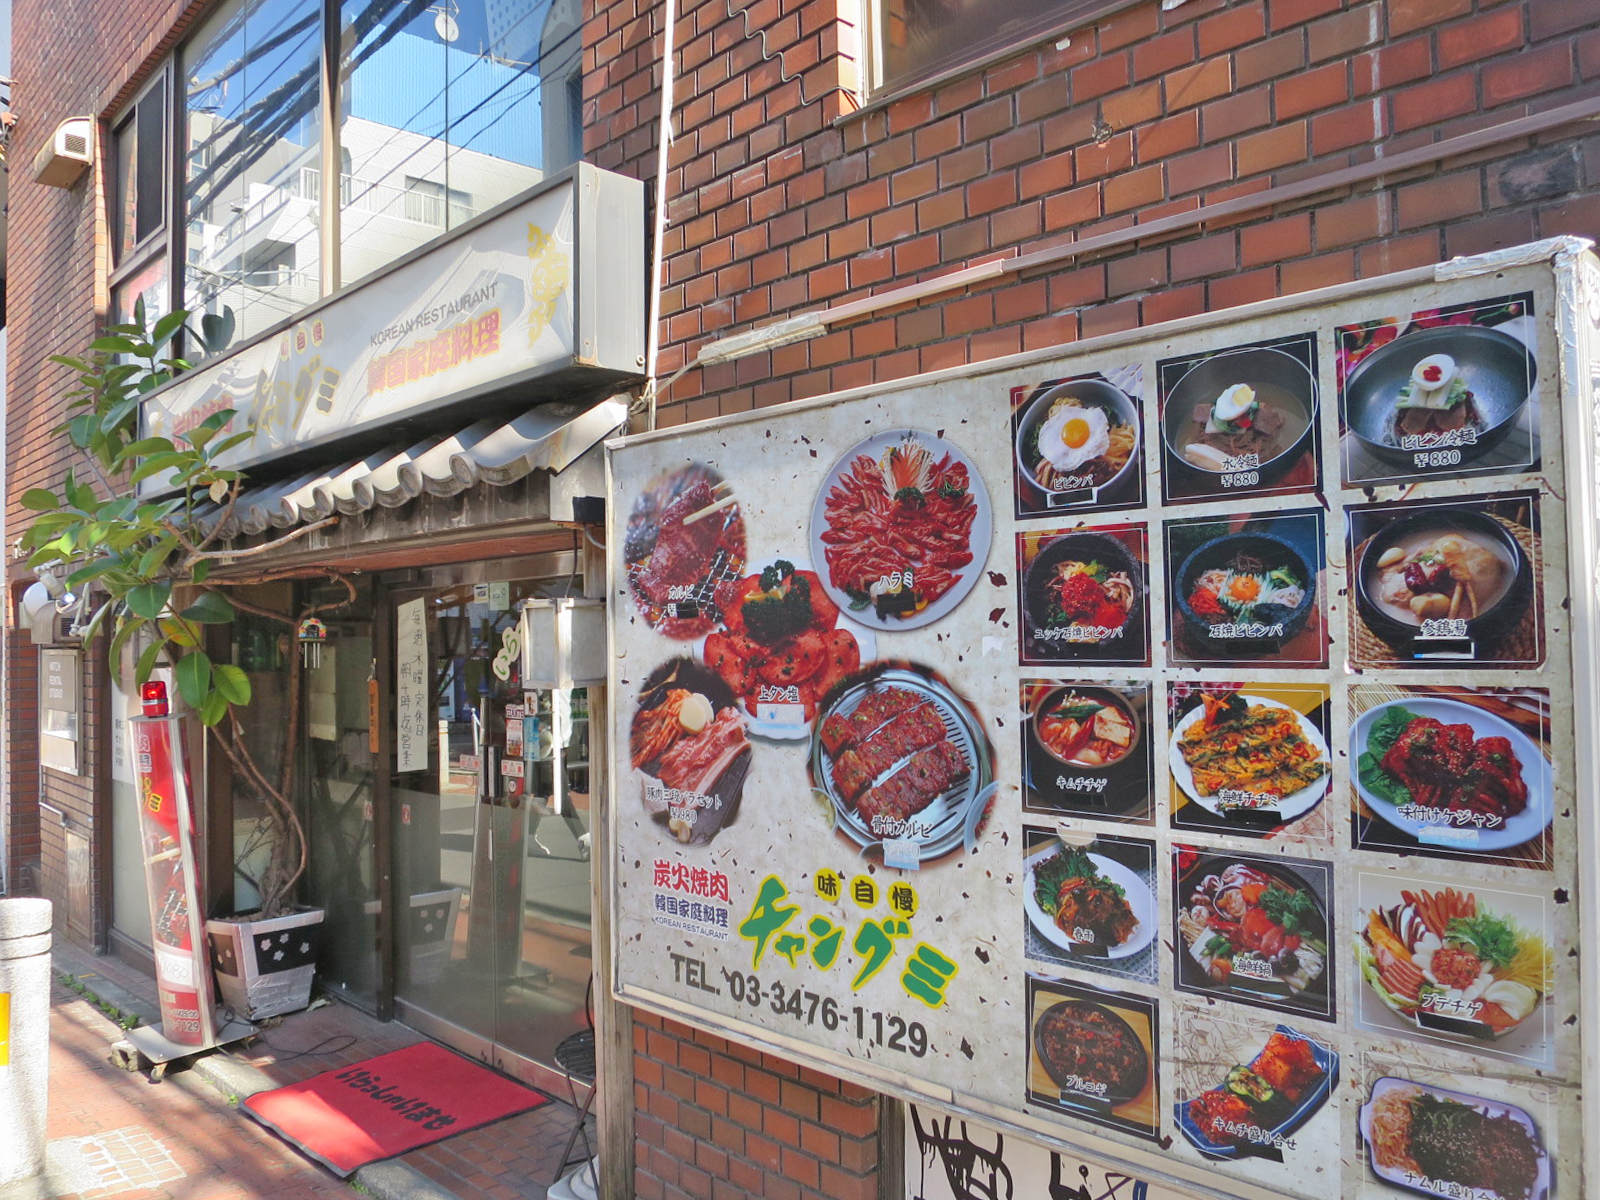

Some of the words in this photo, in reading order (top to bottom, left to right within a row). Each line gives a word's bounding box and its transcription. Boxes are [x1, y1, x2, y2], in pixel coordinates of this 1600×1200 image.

[370, 319, 413, 348] KOREAN
[416, 282, 498, 331] RESTAURANT
[1401, 428, 1478, 451] ビビン冷麺
[1221, 454, 1259, 471] 水冷麺
[1414, 450, 1462, 468] ¥880
[1221, 472, 1259, 487] ¥880
[878, 572, 914, 588] ハラミ
[668, 584, 695, 600] カルビ
[1208, 623, 1283, 638] 石焼ビビンバ
[1420, 619, 1467, 637] 参鶏湯
[758, 686, 800, 702] 上タン塩
[1056, 775, 1107, 793] キムチチゲ
[1218, 789, 1279, 808] 海鮮チヂミ
[871, 815, 932, 839] 骨付カルビ
[1396, 804, 1502, 830] 味付けケジャン
[653, 859, 729, 902] 炭火焼肉
[817, 873, 913, 912] 味自慢
[655, 893, 729, 928] 韓国家庭料理
[655, 916, 681, 928] KOREAN
[683, 923, 729, 940] RESTAURANT
[1073, 927, 1095, 943] 春雨
[739, 874, 959, 1009] チャングミ
[1233, 957, 1273, 978] 海鮮鍋
[670, 952, 720, 995] TEL.
[729, 970, 928, 1059] 03-3476-1129
[334, 1067, 457, 1131] いらっしゃいませ
[1213, 1116, 1298, 1151] キムチ盛り合せ
[1404, 1171, 1508, 1200] ナムル盛り合
